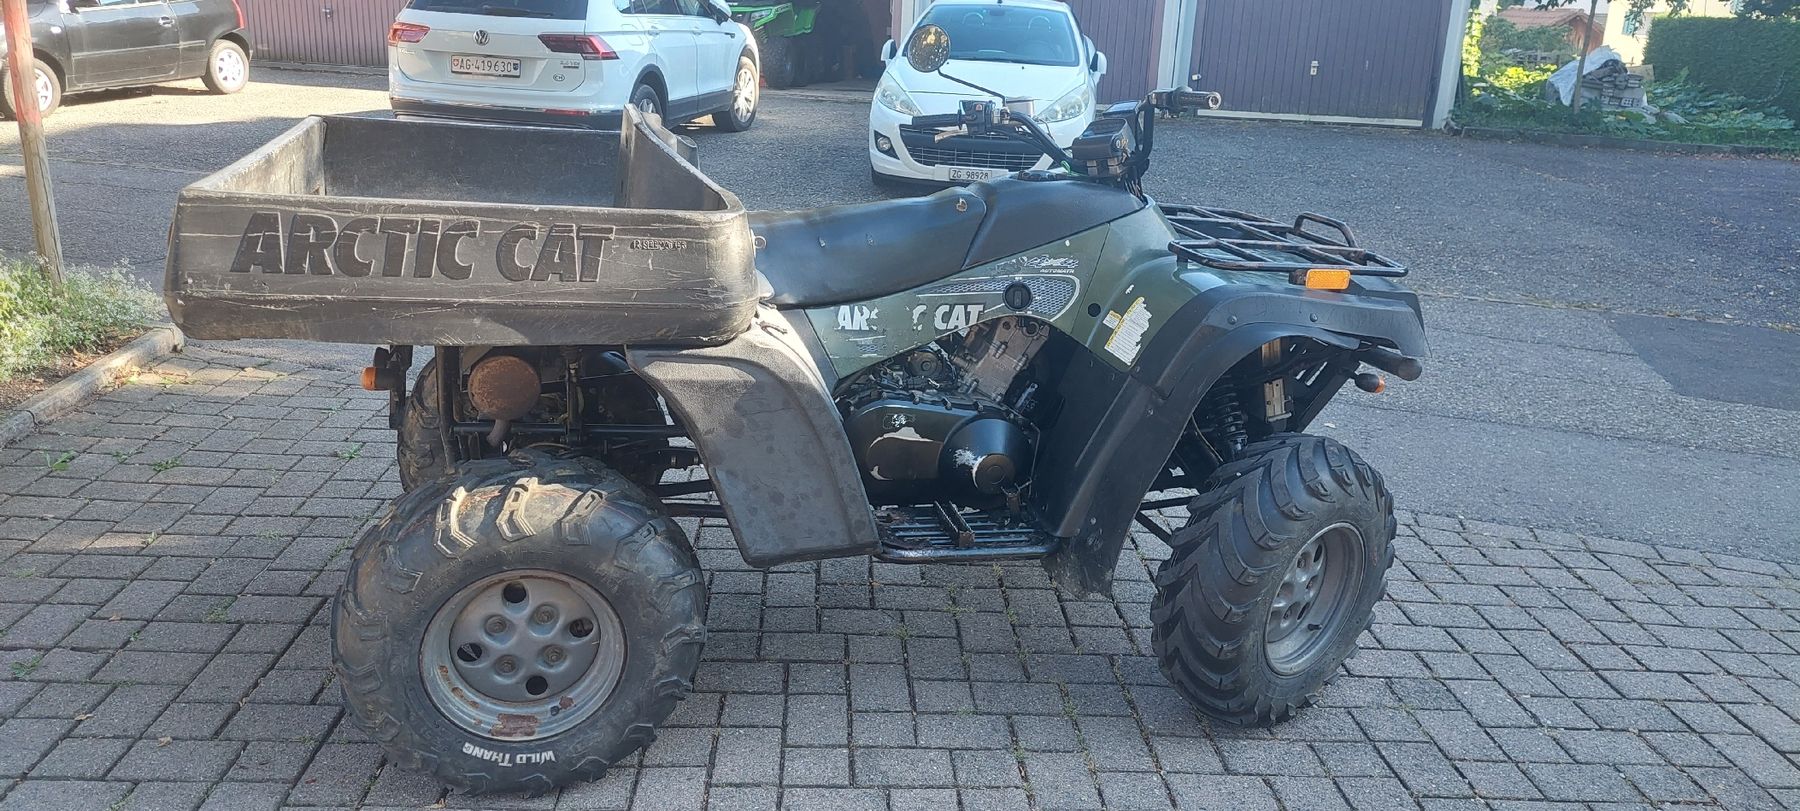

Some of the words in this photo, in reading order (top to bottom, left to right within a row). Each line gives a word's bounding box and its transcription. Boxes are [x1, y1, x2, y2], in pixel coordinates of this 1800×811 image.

[229, 211, 480, 279] ARCTIC
[496, 222, 616, 282] CAT
[934, 304, 985, 332] CAT
[462, 742, 513, 767] THANG
[515, 750, 558, 765] WILD
